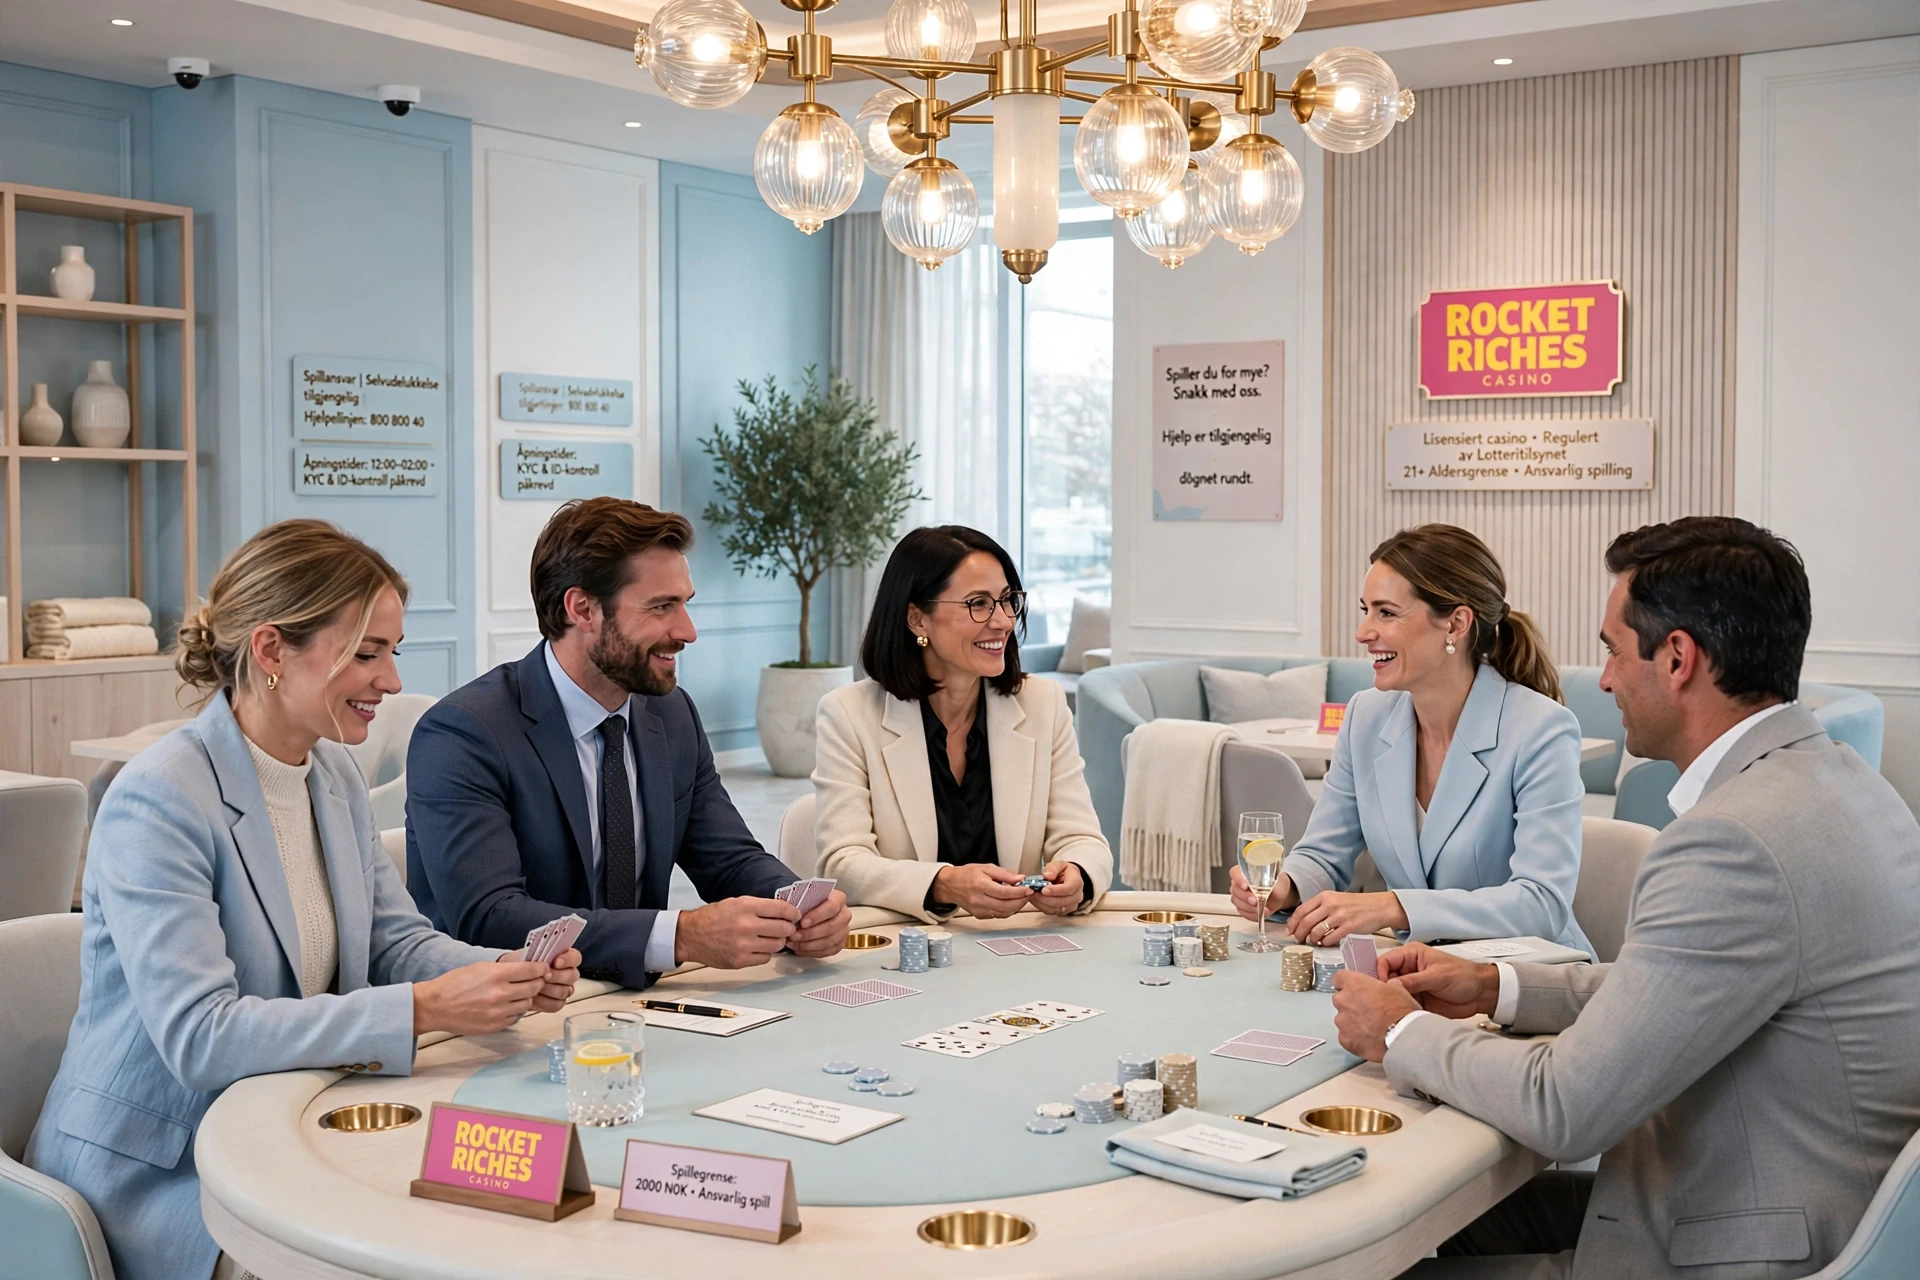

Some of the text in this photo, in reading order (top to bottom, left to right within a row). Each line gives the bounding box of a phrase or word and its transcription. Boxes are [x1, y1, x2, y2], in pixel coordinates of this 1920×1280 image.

[1447, 297, 1595, 337] ROCKET
[1448, 334, 1587, 372] RICHES
[1166, 364, 1270, 384] Spiller du for mye?
[1482, 373, 1552, 387] CASINO
[1173, 384, 1262, 400] Snakk med oss.
[370, 414, 389, 426] 800
[392, 415, 410, 427] 800
[413, 416, 425, 427] 40
[1162, 428, 1271, 447] Hjelp er tilgjengelig
[1423, 431, 1482, 445] Lisensiert
[1487, 432, 1527, 445] casino
[1543, 430, 1599, 447] Regulert
[304, 454, 368, 472] Åpningstider:
[1459, 448, 1567, 462] av Lotteritilsynet
[517, 463, 600, 476] KYC & ID-kontroll
[1220, 471, 1253, 485] rundt.
[1404, 466, 1425, 478] 21+
[1428, 464, 1509, 480] Aldersgrense
[1524, 464, 1583, 480] Ansvarlig
[1587, 464, 1633, 480] spilling
[304, 473, 425, 489] KYC & ID-kontroll påkrevd
[454, 1120, 542, 1157] ROCKET
[451, 1146, 533, 1182] RICHES
[468, 1175, 510, 1189] CASINO
[671, 1163, 737, 1184] Spillegrense:
[635, 1178, 662, 1193] 2000
[664, 1182, 688, 1197] NOK
[698, 1187, 747, 1209] Ansvarlig
[749, 1195, 771, 1211] spill
